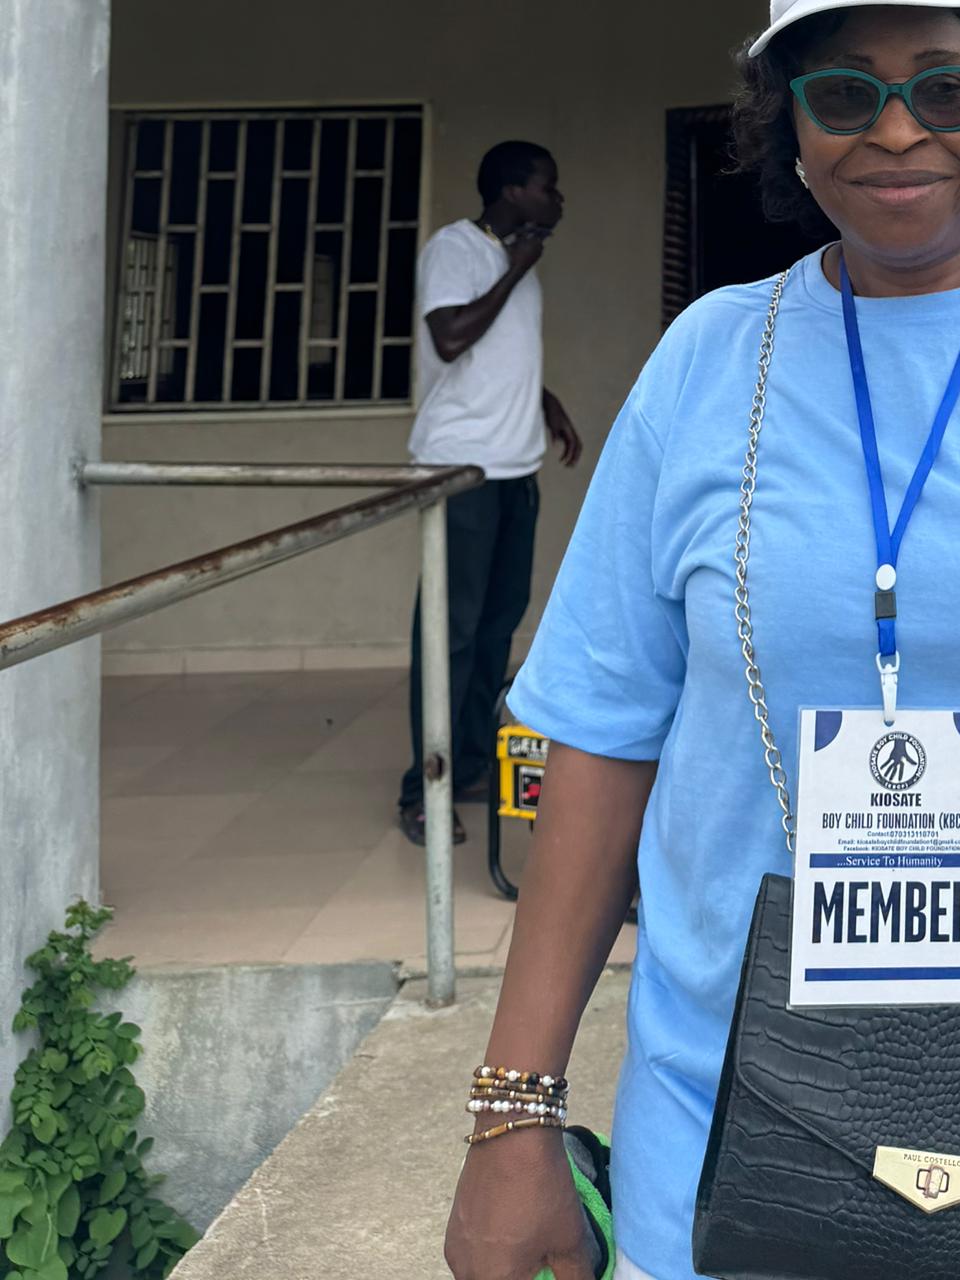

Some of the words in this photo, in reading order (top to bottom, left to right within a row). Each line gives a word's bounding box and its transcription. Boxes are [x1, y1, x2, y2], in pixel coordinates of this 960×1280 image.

[870, 792, 922, 807] KIOSATE
[822, 812, 842, 829] BOY
[845, 812, 873, 829] CHILD
[876, 812, 935, 829] FOUNDATION
[883, 856, 895, 866] To
[897, 856, 943, 868] Humanity
[903, 1153, 922, 1162] PAUL
